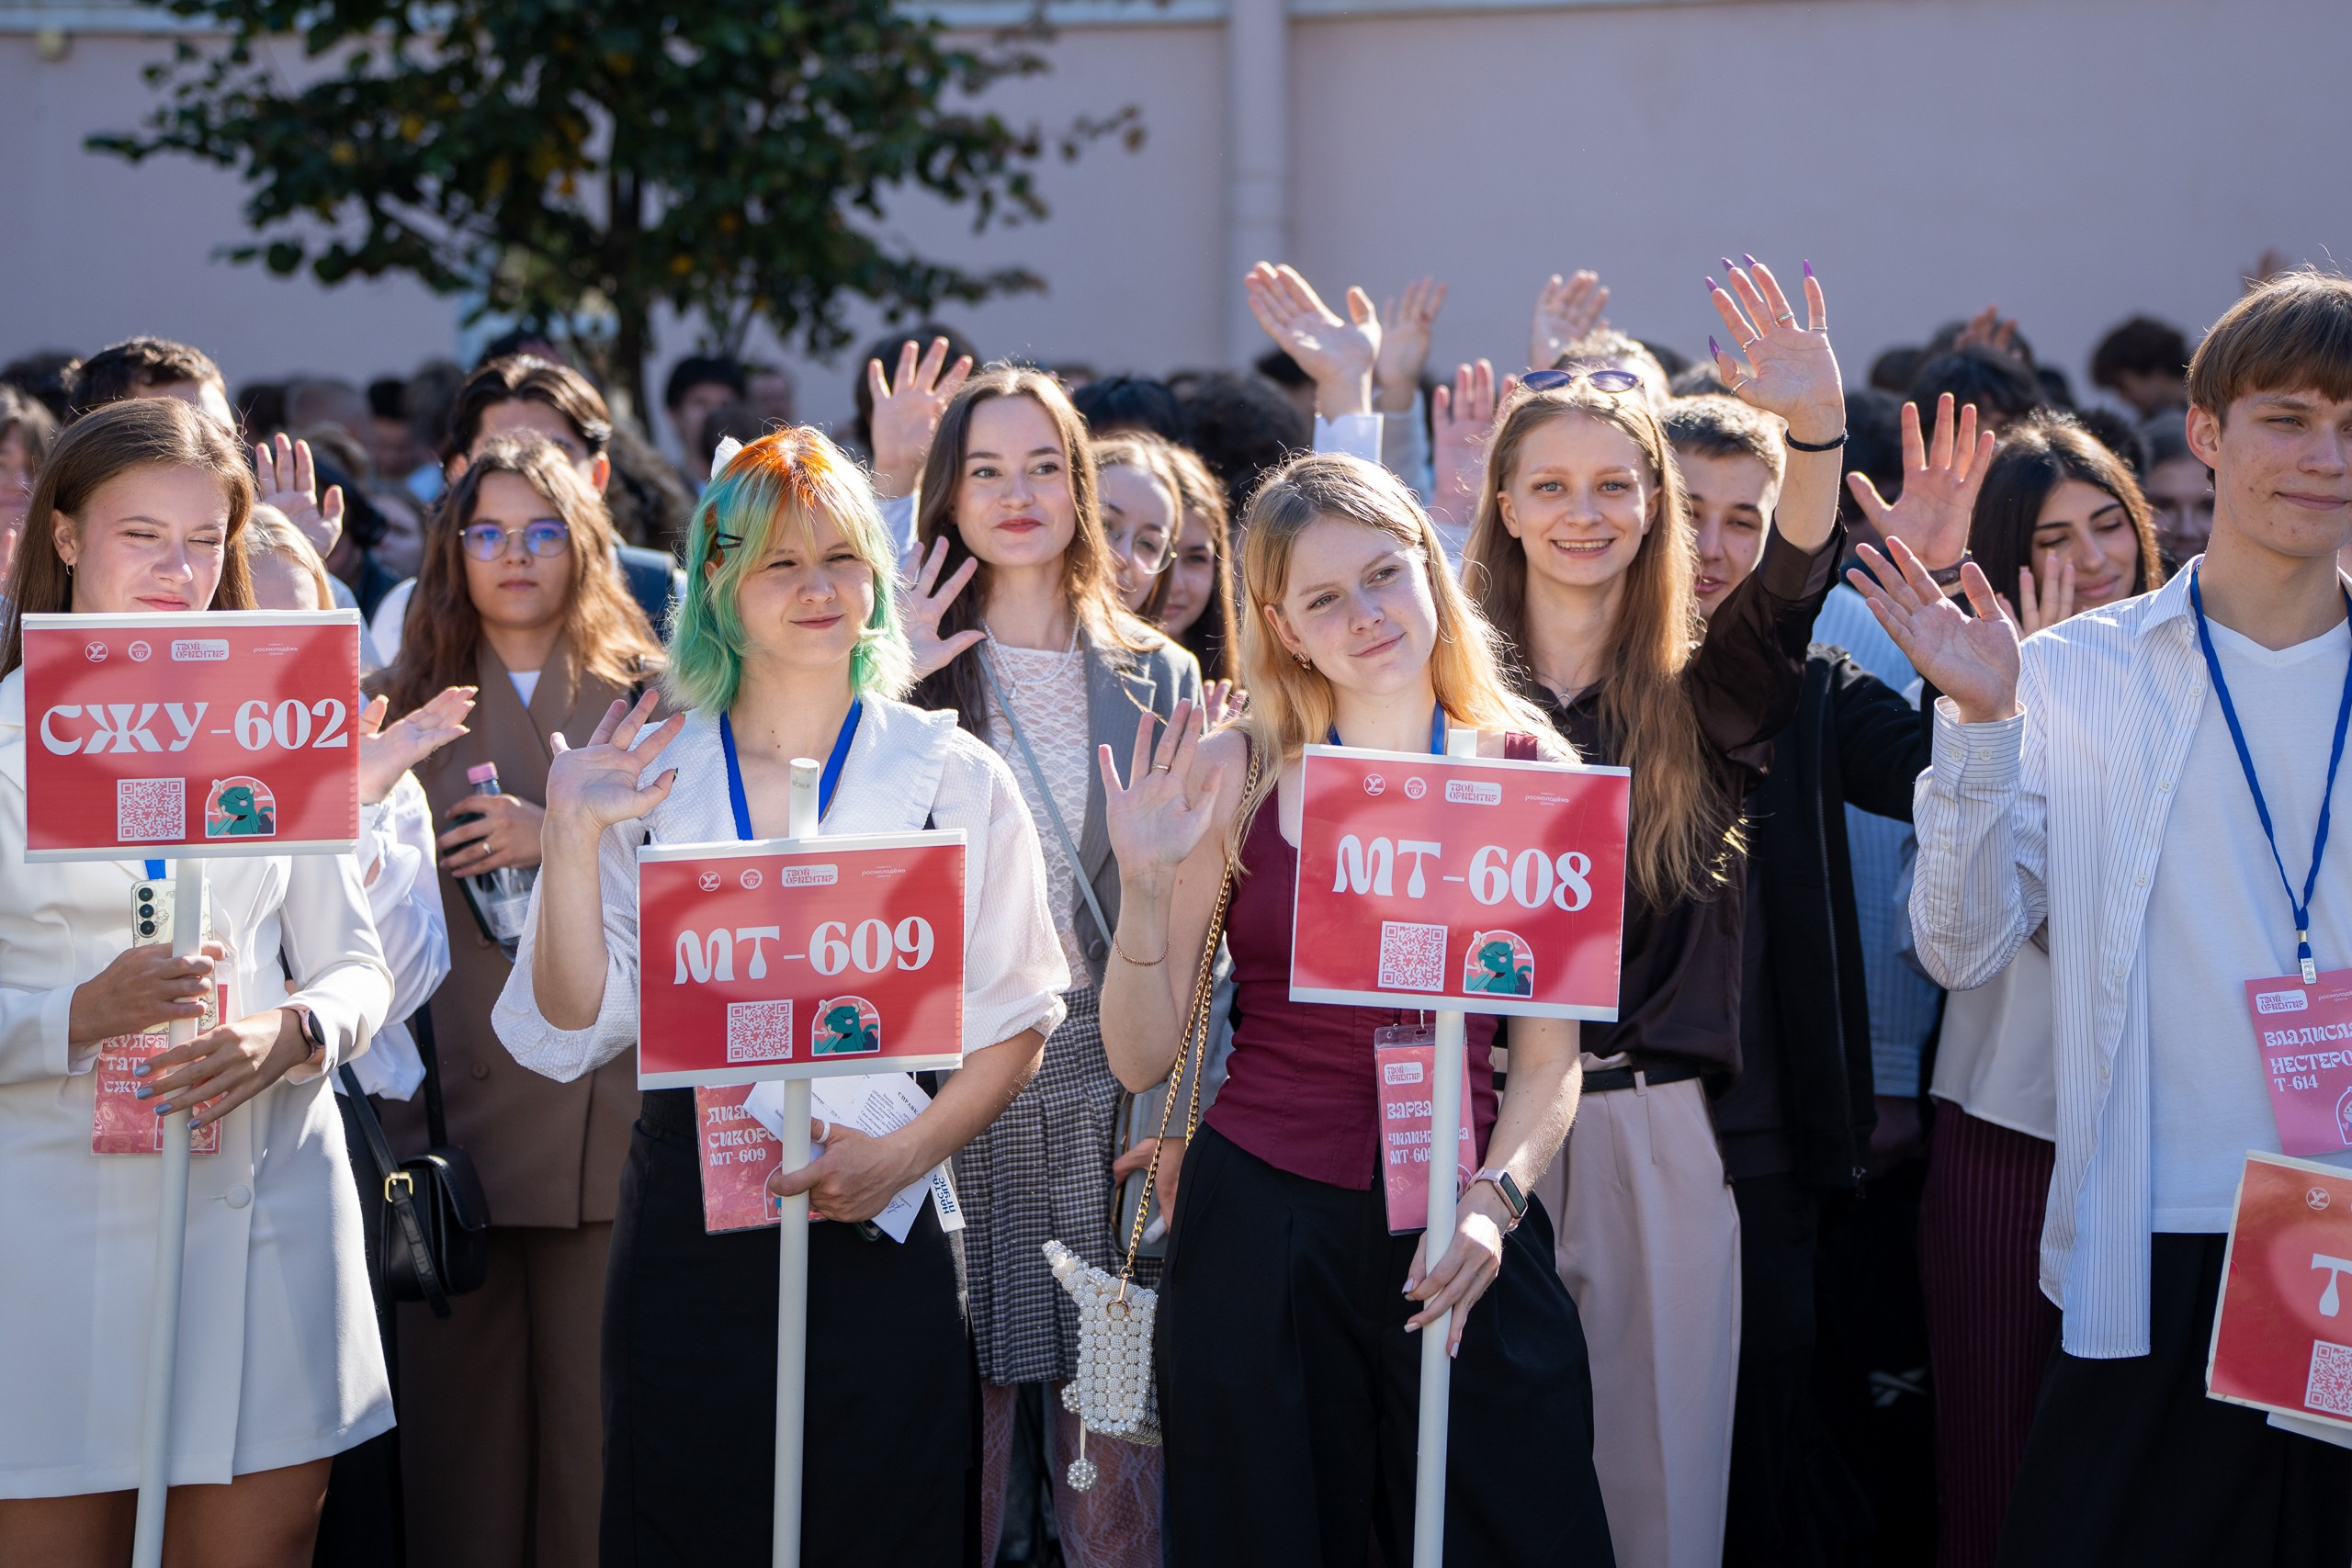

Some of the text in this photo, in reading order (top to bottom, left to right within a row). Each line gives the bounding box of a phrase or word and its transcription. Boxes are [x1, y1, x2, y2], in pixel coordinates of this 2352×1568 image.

[175, 642, 200, 650] ТВОЙ
[175, 650, 225, 659] ОРИЕНТИР
[40, 698, 348, 756] СЖУ-602
[1450, 783, 1474, 793] ТВОЙ
[1449, 791, 1498, 803] ОРИЕНТИР
[786, 867, 810, 877] ТВОЙ
[786, 874, 834, 885] ОРИЕНТИР
[1332, 834, 1592, 912] МТ-608
[673, 916, 935, 986] МТ-609
[2259, 994, 2281, 1004] ТВОЙ
[2261, 999, 2304, 1011] ОРИЕНТИР
[2273, 1074, 2319, 1092] Т-614
[707, 1104, 752, 1127] ДИА
[709, 1147, 766, 1167] МТ-609
[933, 1174, 950, 1214] НАСТА
[938, 1177, 956, 1213] ПГУПС
